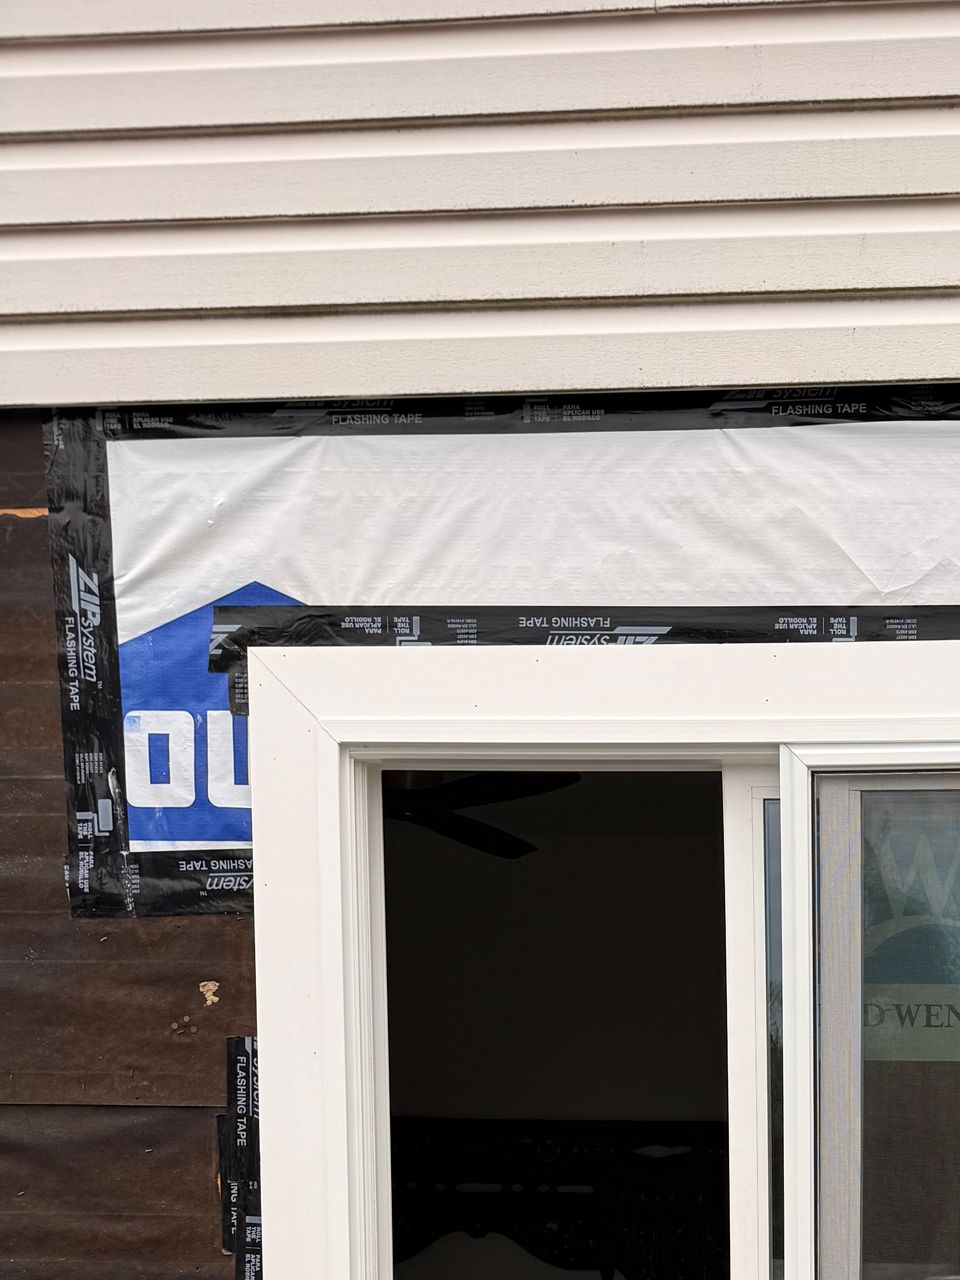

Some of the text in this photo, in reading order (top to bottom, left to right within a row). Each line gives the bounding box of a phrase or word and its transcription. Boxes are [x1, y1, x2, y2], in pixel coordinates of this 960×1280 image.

[772, 403, 867, 416] FLASHING TAPE
[332, 414, 422, 425] FLASHING TAPE
[519, 617, 610, 627] FLASHING TAPE
[65, 617, 80, 711] FLASHING TAPE
[179, 861, 207, 870] TAPE
[237, 1056, 246, 1147] FLASHING TAPE
